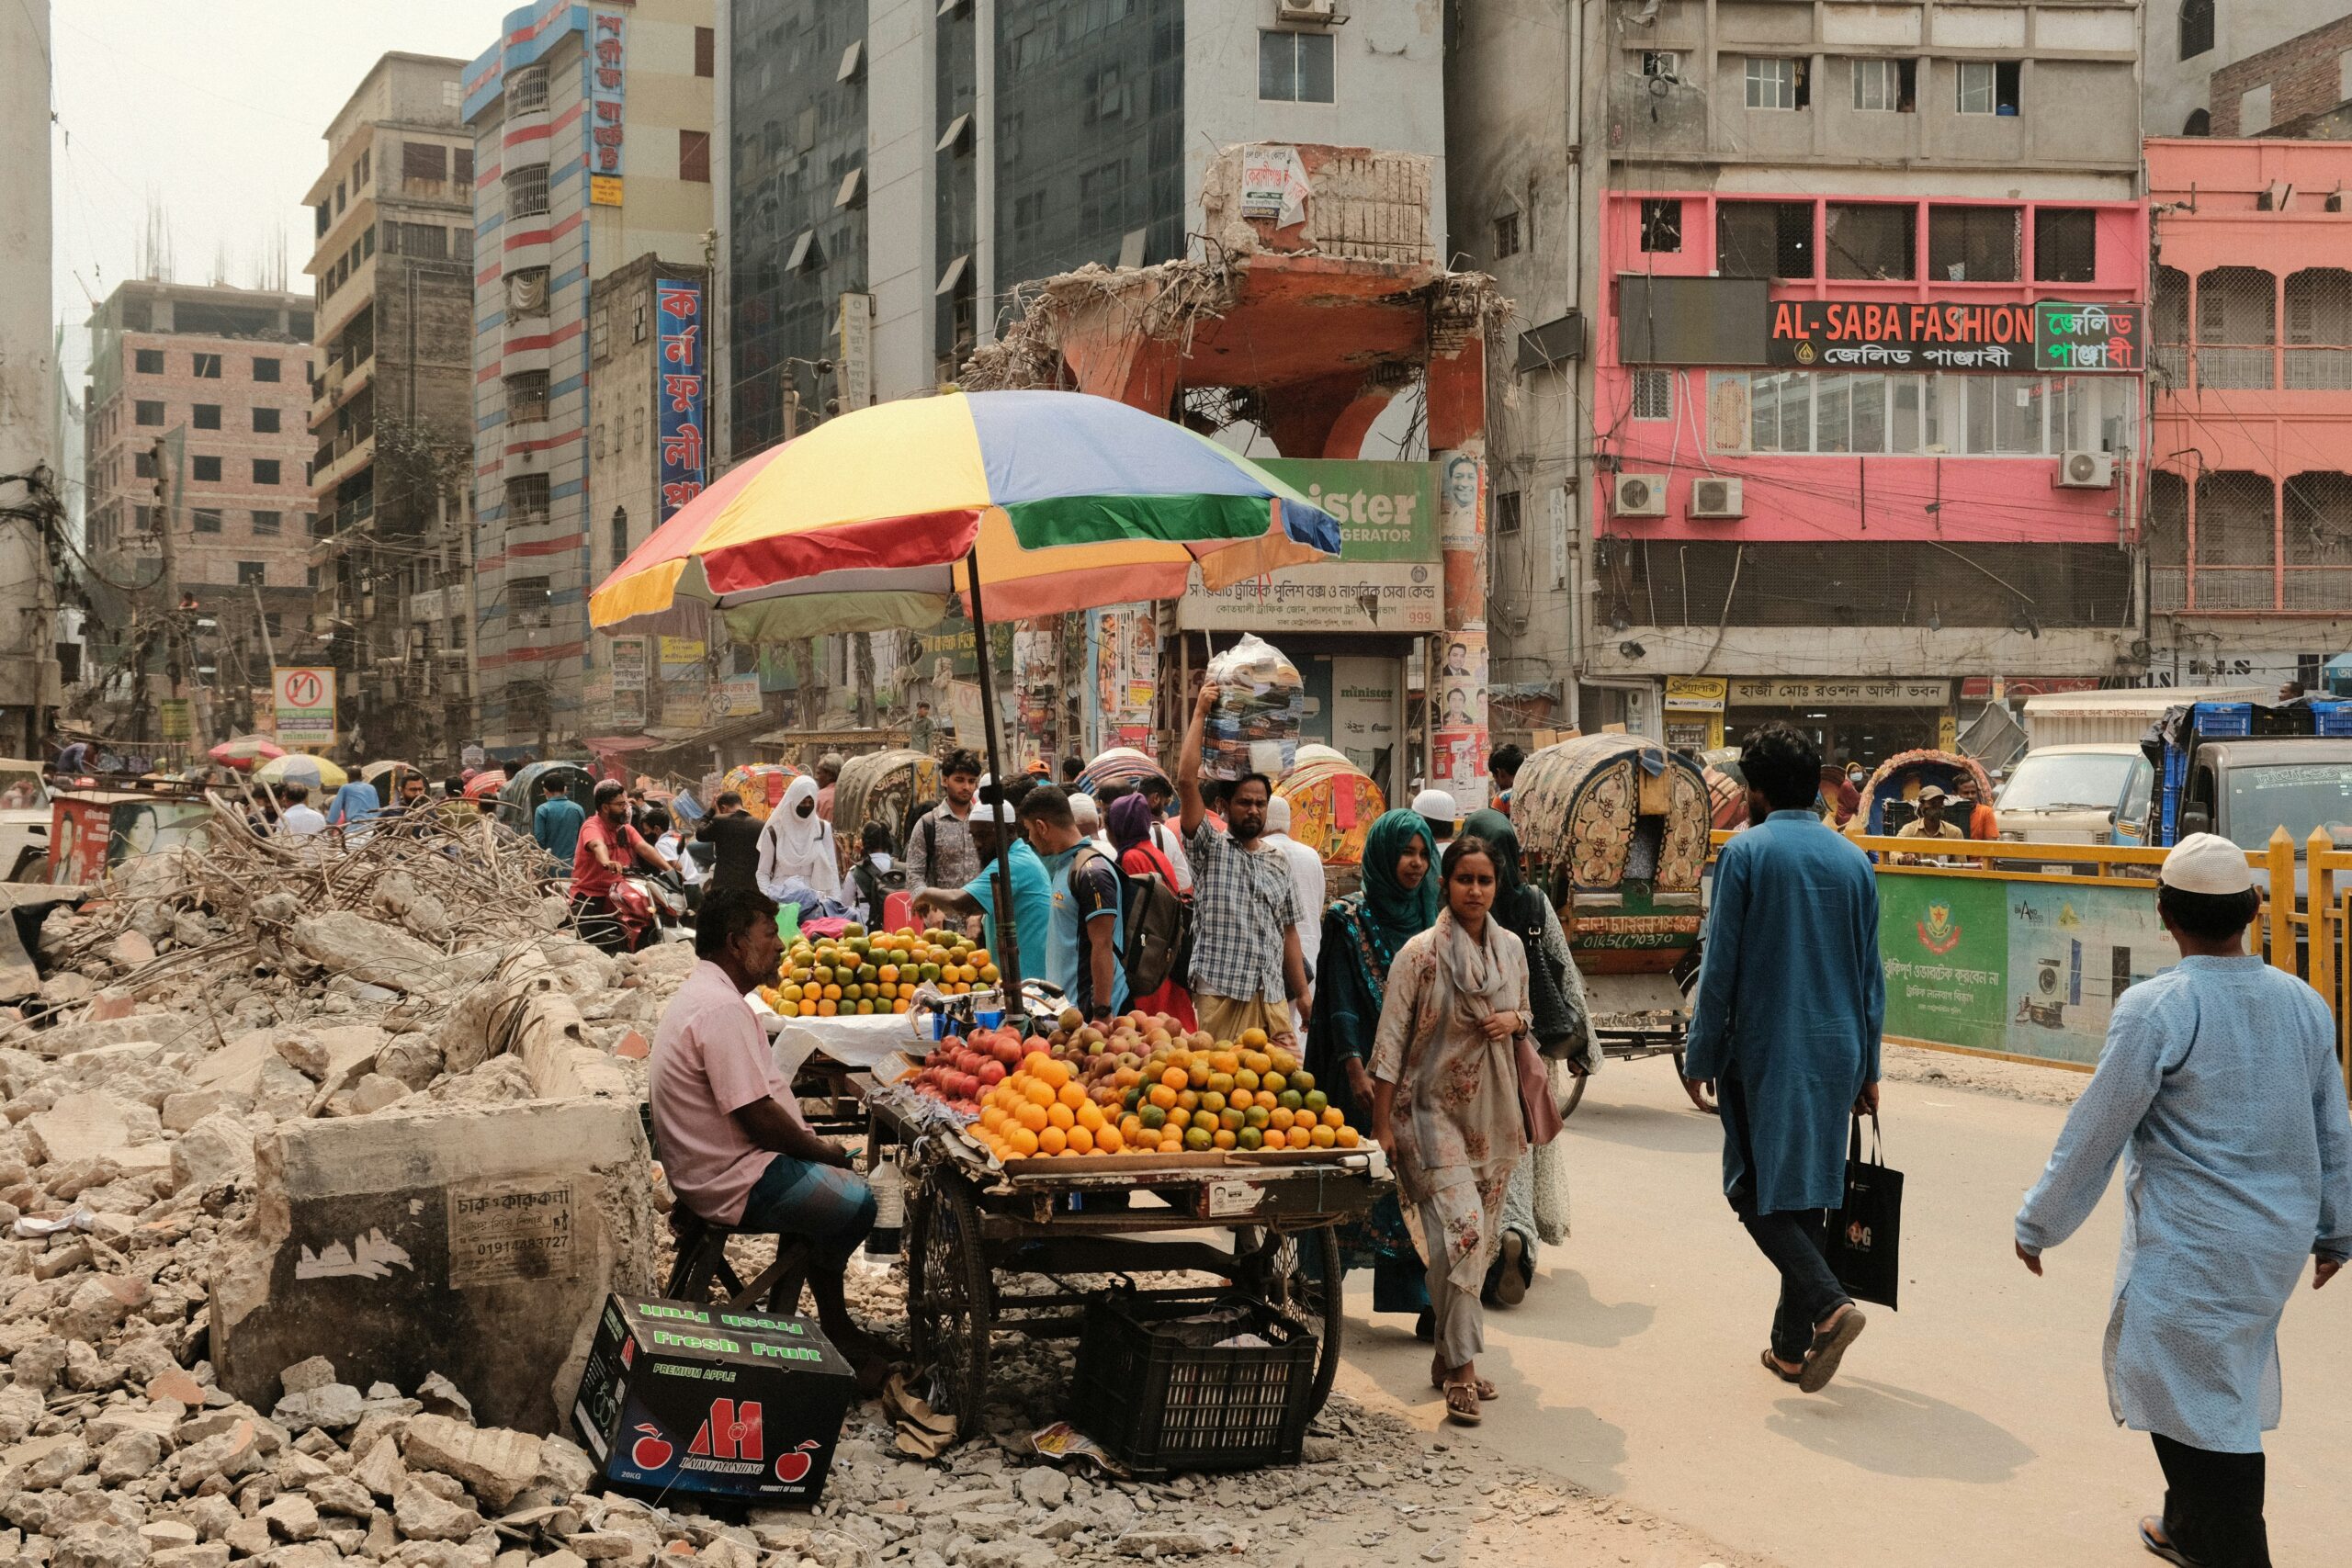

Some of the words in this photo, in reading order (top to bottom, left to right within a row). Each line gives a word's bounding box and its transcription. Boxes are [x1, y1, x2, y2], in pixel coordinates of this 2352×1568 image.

[1772, 302, 1819, 340] AL-
[1826, 304, 1902, 342] SABA
[1910, 306, 2034, 344] FASHION
[2046, 307, 2133, 337] জেলিড
[1824, 344, 1913, 365] জেলিড
[1922, 345, 2013, 367] পাঞ্জাবী
[2048, 337, 2134, 368] পাঞ্জাবী
[1307, 483, 1417, 525] ister
[1341, 528, 1411, 542] GERATOR
[1273, 580, 1305, 603] পুলিশ
[1306, 584, 1327, 598] বক্স
[1329, 585, 1337, 598] ও
[1383, 585, 1407, 599] সেবা
[1408, 585, 1435, 599] কেন্দ্র
[1344, 604, 1365, 615] ট্রাফি
[1409, 611, 1432, 624] 999
[1340, 685, 1394, 698] minister
[1739, 679, 1774, 699] হাজী
[1779, 684, 1809, 698] মোঃ
[1815, 685, 1860, 698] রওশন
[1866, 681, 1905, 698] আলী
[1906, 685, 1942, 698] ভবন
[1989, 971, 2000, 986] না
[458, 1197, 490, 1215] চারু
[638, 1303, 710, 1324] Fruit
[721, 1313, 805, 1335] Fresh
[653, 1330, 740, 1353] Fresh
[751, 1341, 823, 1362] Fruit
[653, 1363, 701, 1379] PREMIUM
[703, 1368, 737, 1382] APPLE
[620, 1470, 641, 1481] 20KG
[759, 1484, 782, 1493] PRODUCT
